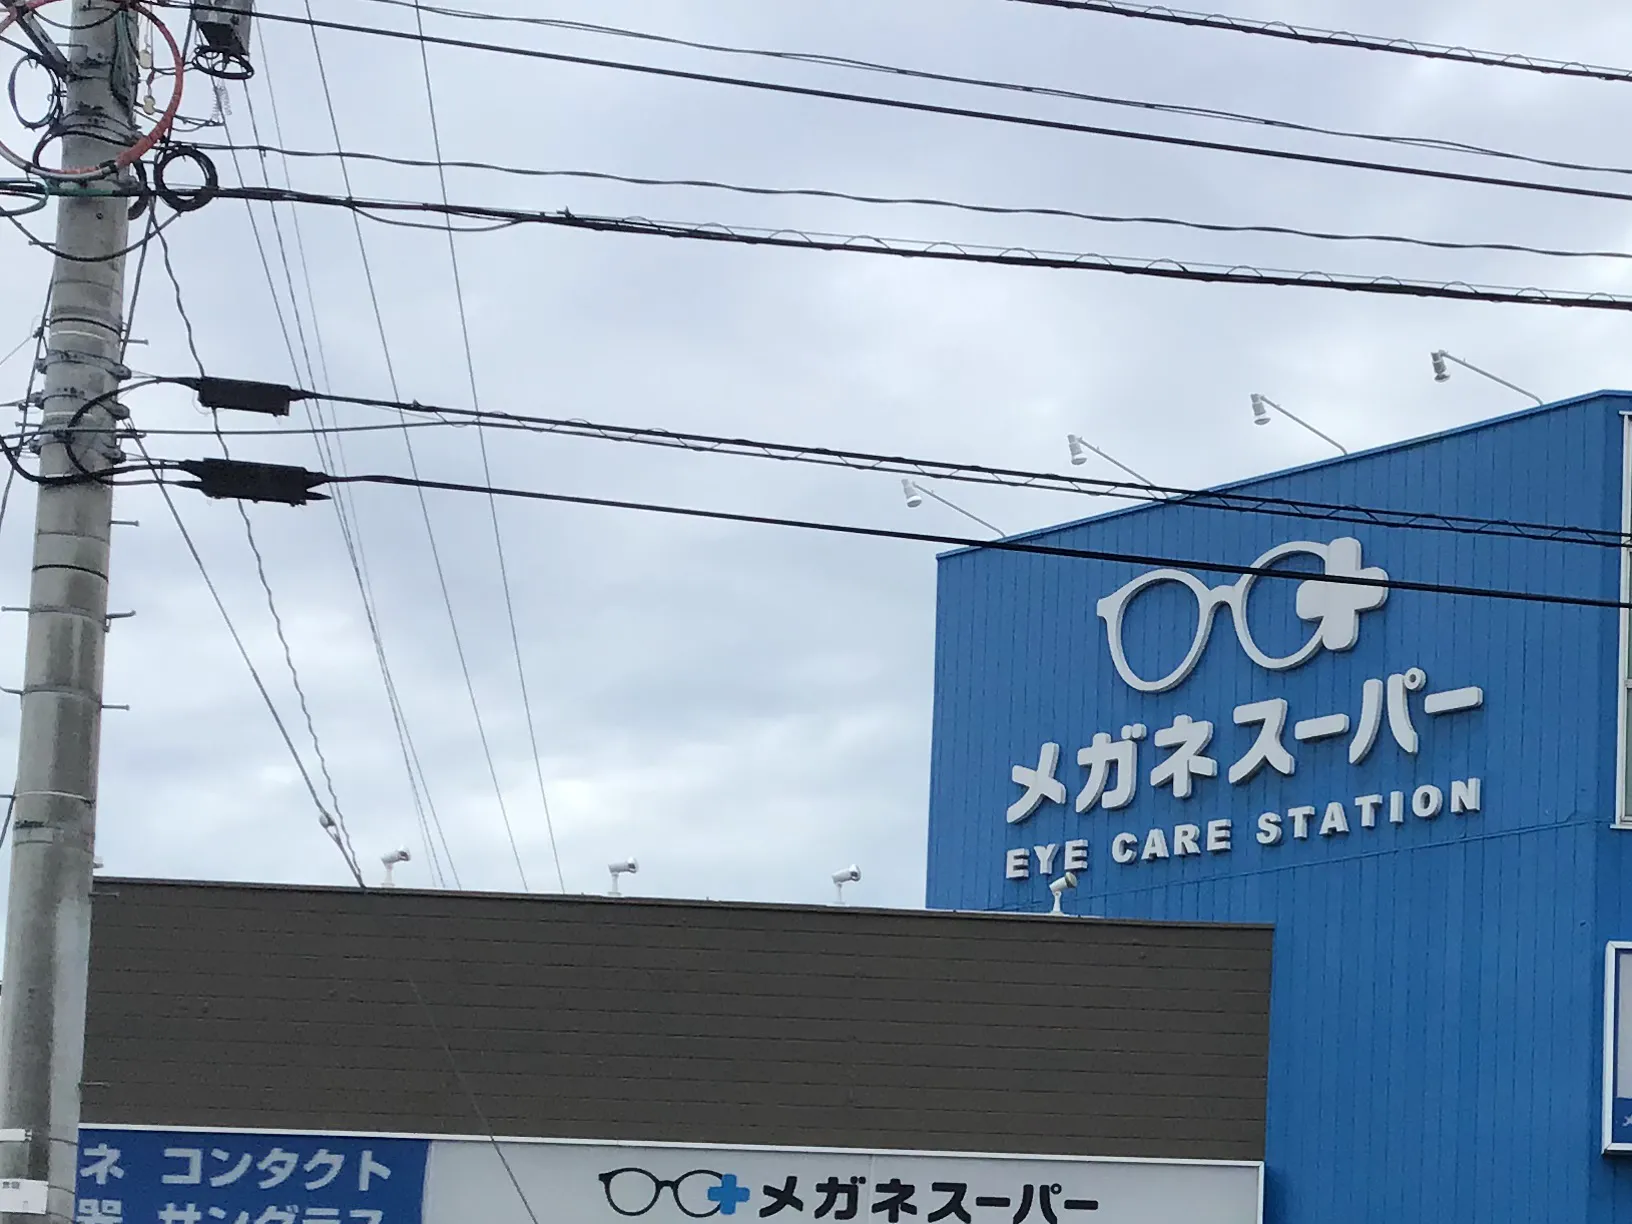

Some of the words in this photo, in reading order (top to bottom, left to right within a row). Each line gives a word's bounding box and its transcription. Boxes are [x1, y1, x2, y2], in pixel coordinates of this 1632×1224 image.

[1006, 667, 1484, 825] メガネスーパー
[1005, 839, 1088, 880] EYE
[1111, 818, 1232, 865] CARE
[1256, 778, 1482, 847] STATION
[161, 1147, 391, 1192] コンタクト
